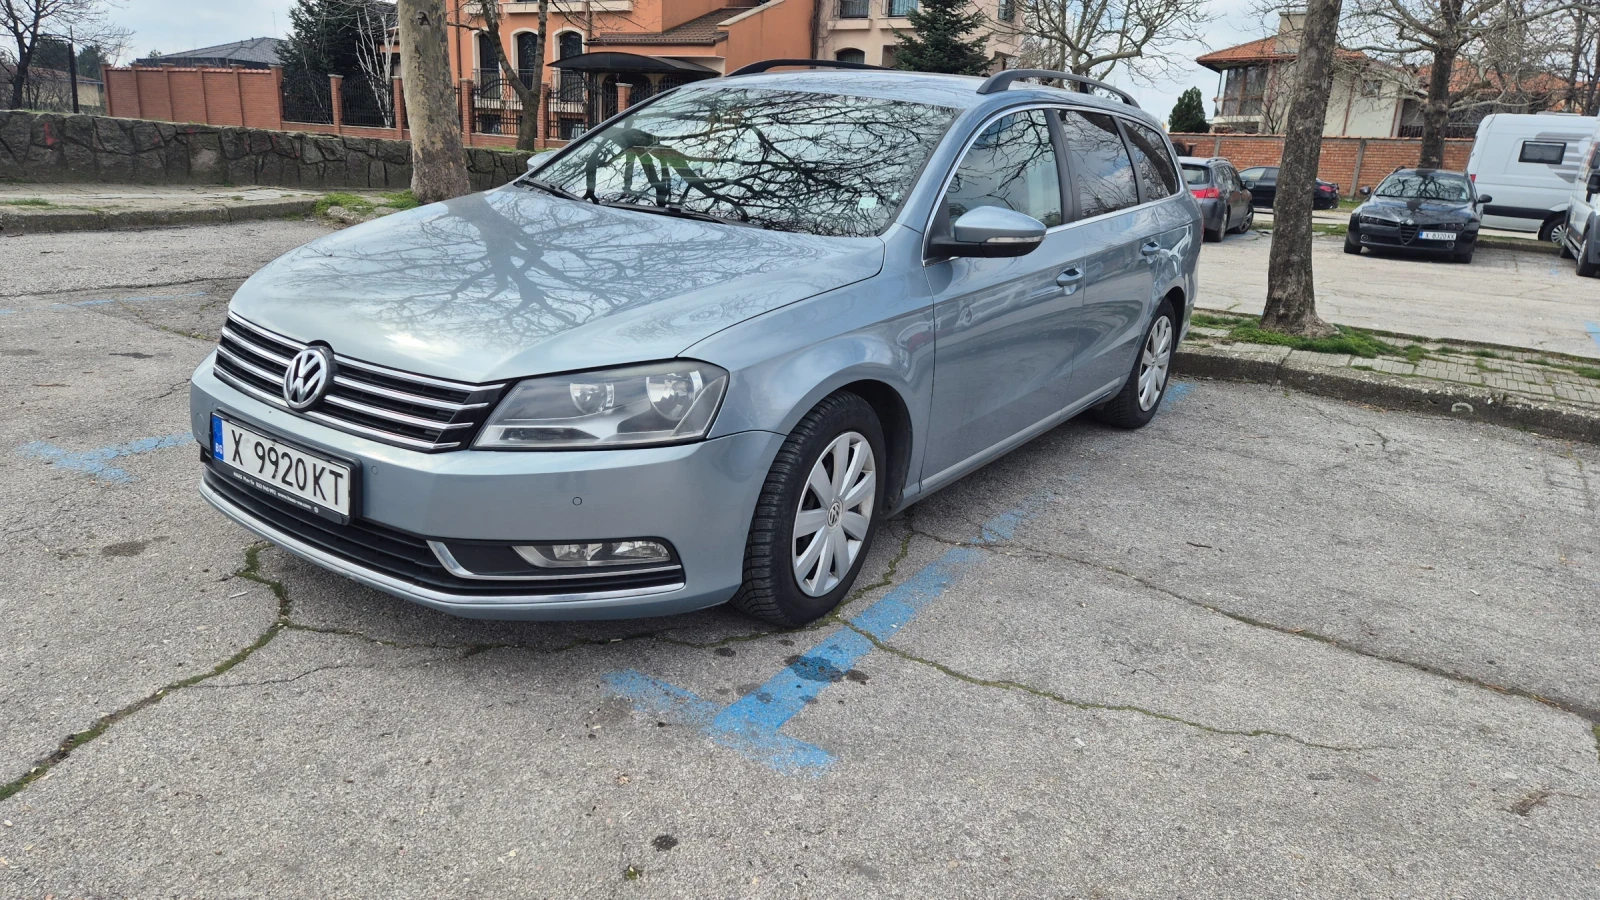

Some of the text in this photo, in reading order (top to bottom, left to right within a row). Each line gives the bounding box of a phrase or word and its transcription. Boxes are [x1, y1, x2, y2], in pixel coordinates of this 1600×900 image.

[284, 349, 327, 408] VW
[215, 442, 223, 455] BG
[231, 429, 244, 466] X
